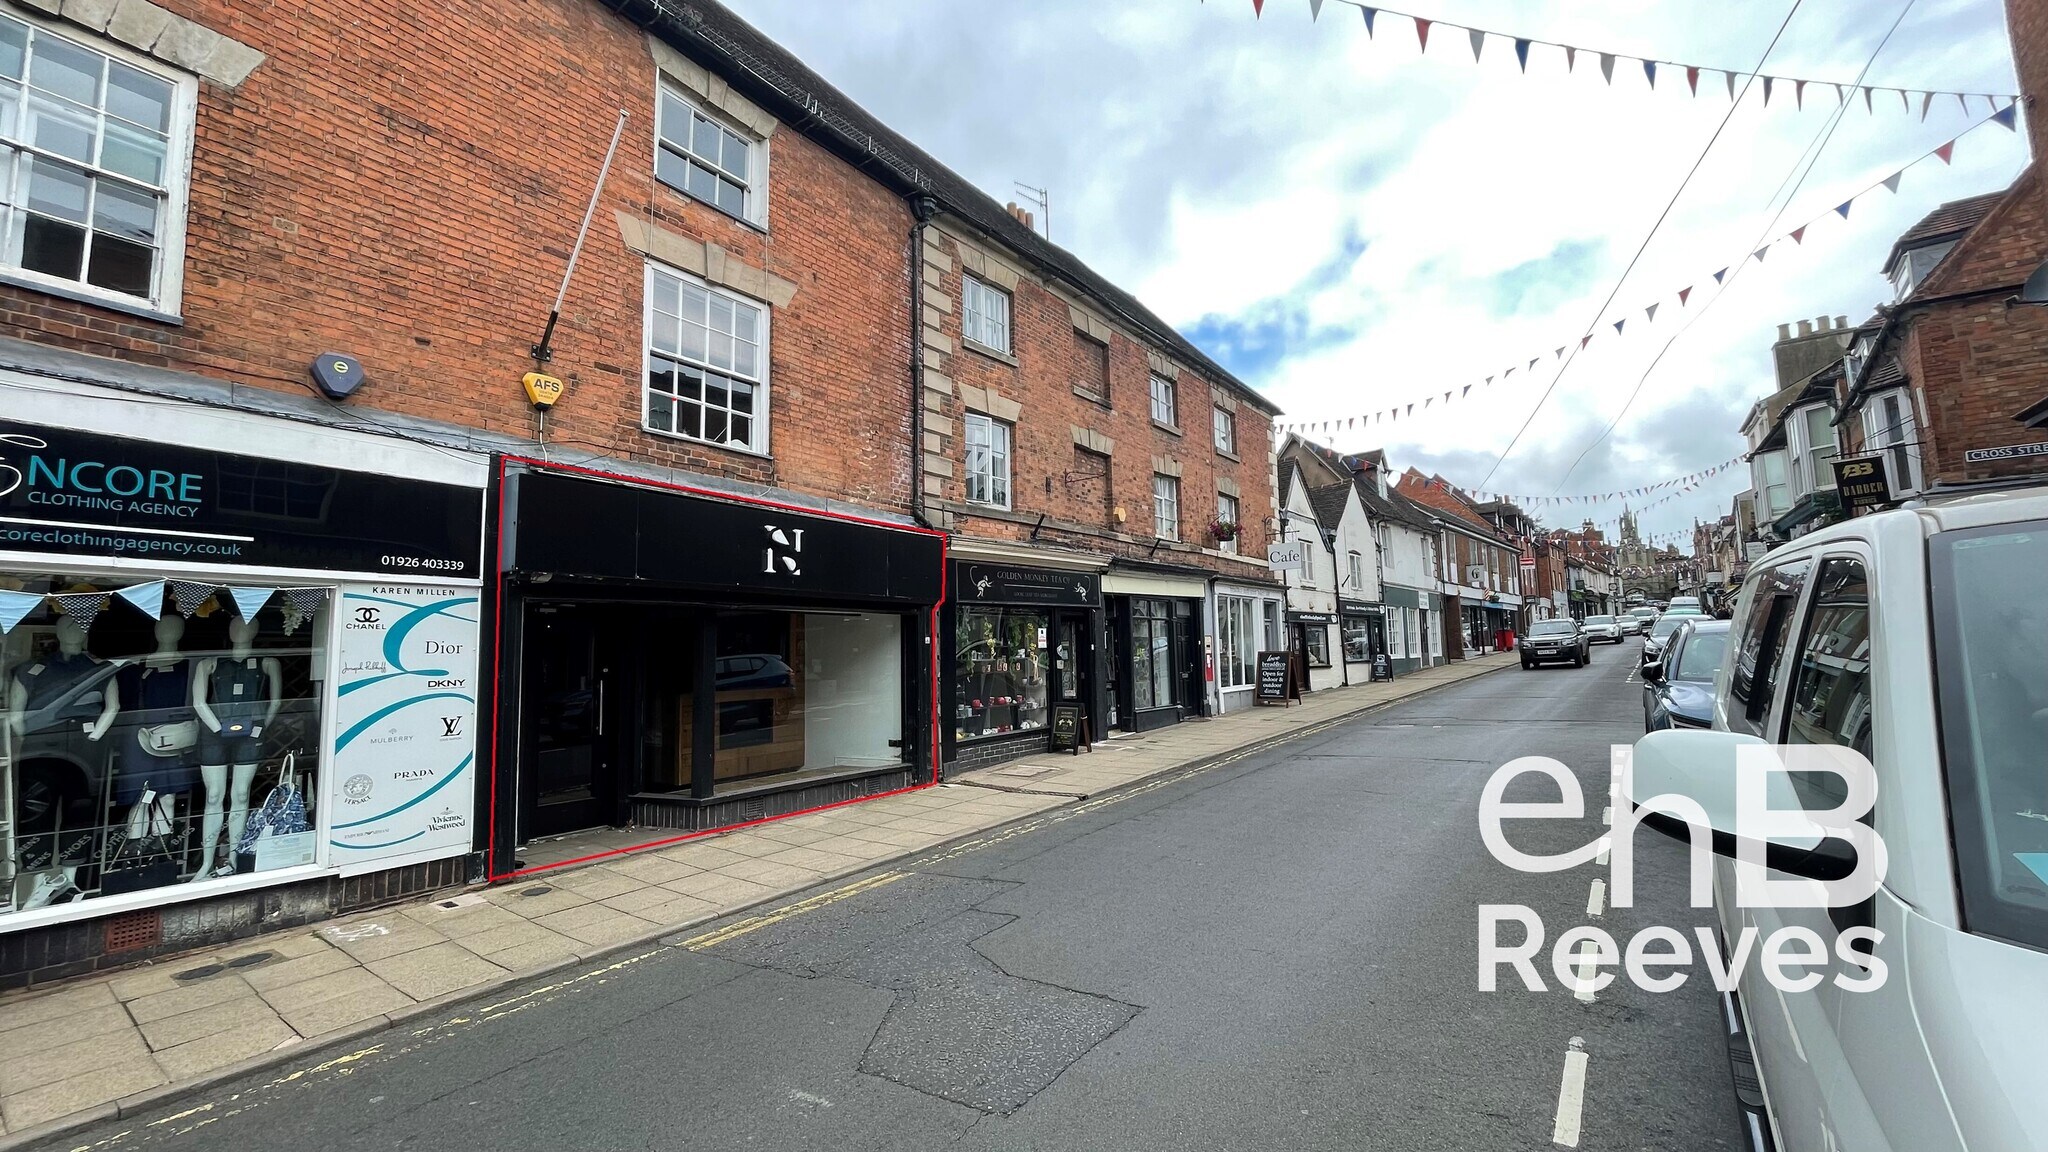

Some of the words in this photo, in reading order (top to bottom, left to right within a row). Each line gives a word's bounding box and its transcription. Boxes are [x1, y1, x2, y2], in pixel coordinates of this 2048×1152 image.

[534, 379, 560, 393] AFS
[1971, 448, 2013, 460] CROSS
[1843, 482, 1884, 497] BARBER
[28, 491, 123, 511] CLOTHING
[128, 501, 199, 517] AGENCY
[381, 555, 420, 567] 01926
[422, 558, 464, 571] 403339
[1270, 550, 1300, 564] Cafe
[997, 571, 1021, 580] GOLDEN
[1025, 573, 1049, 582] MONKEY
[372, 587, 411, 595] KAREN
[417, 588, 455, 596] MILLEN
[425, 641, 463, 654] Dior
[428, 679, 466, 688] DKNY
[370, 735, 414, 744] MULBERRY
[394, 769, 435, 779] PRADA
[170, 825, 195, 845] BAGS
[60, 834, 92, 860] SHOES
